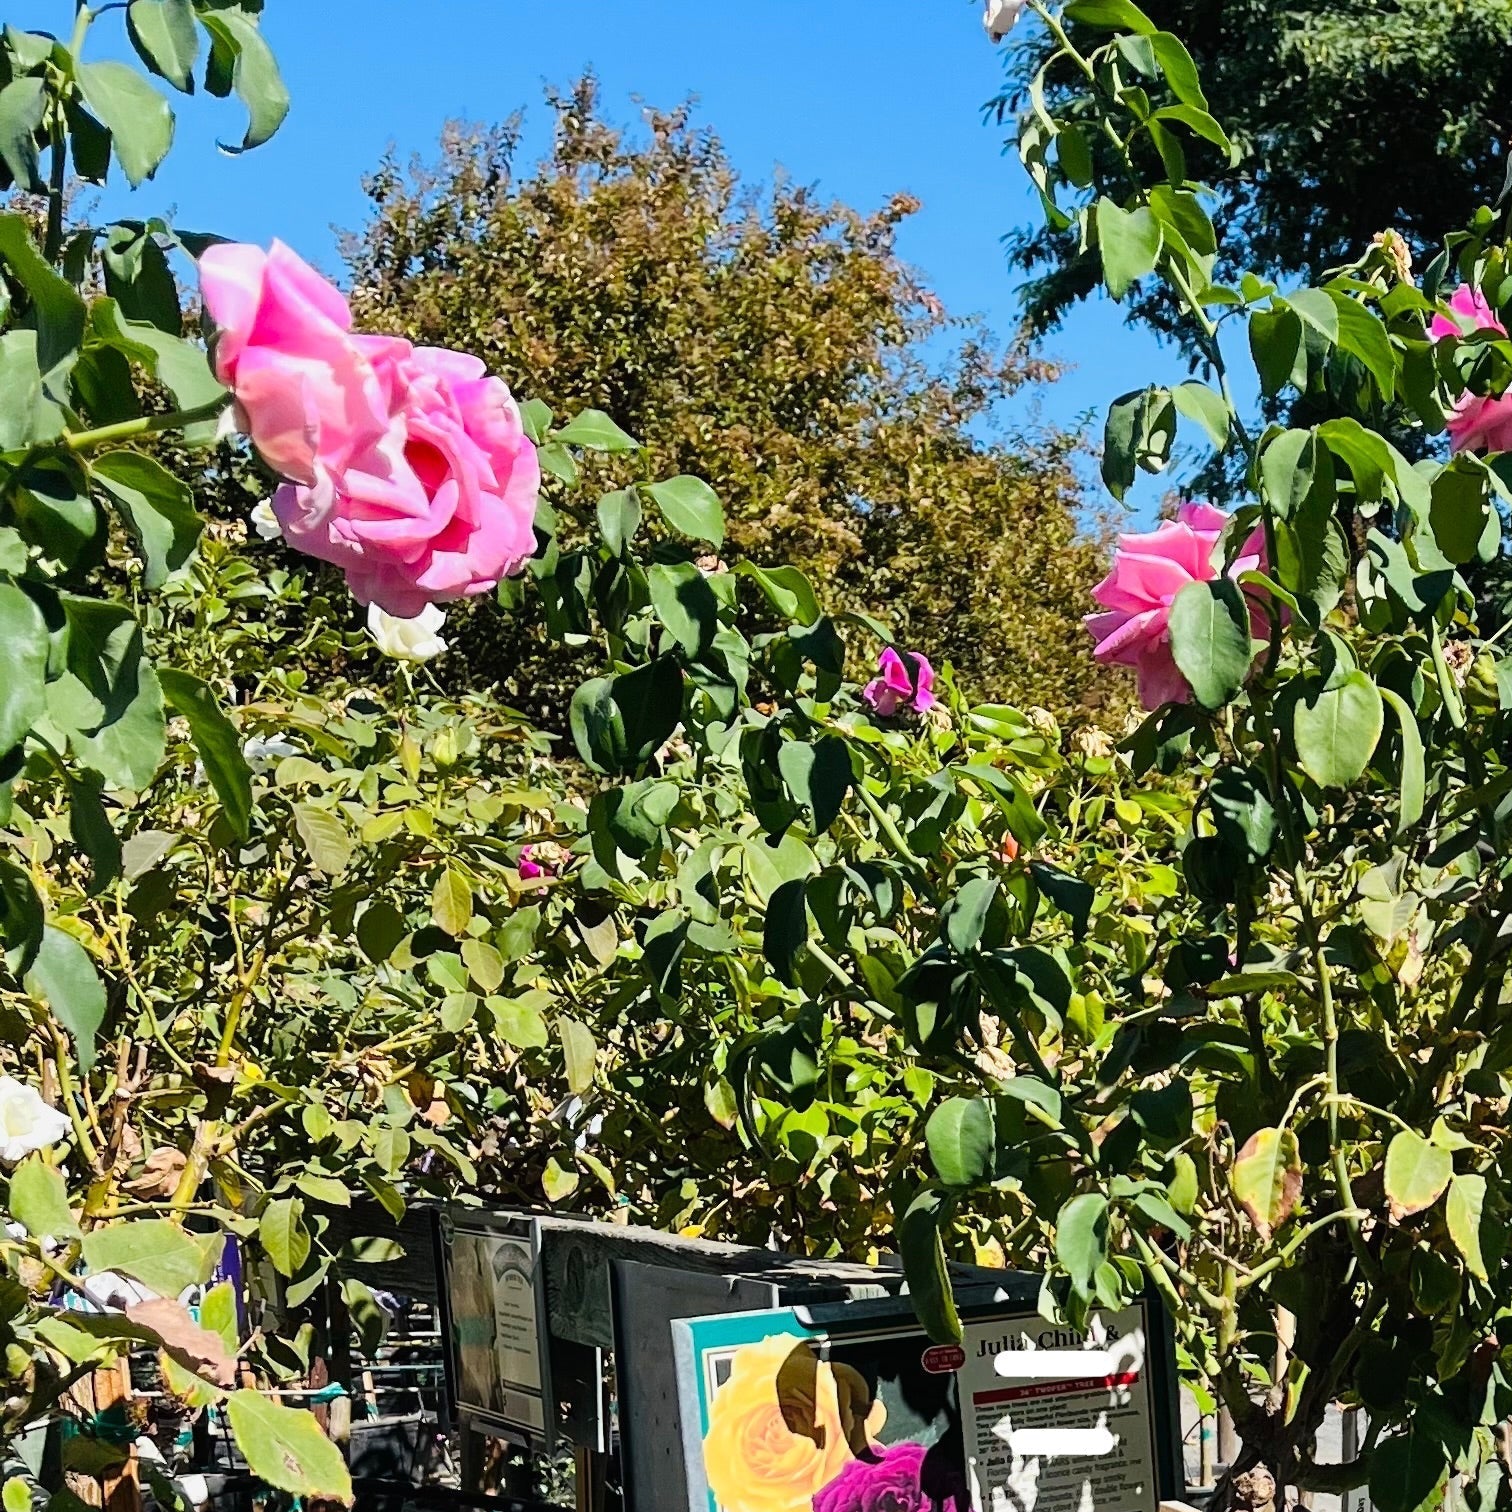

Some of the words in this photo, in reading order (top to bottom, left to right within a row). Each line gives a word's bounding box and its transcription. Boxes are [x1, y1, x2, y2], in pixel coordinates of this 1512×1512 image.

[977, 1334, 1028, 1358] Julia
[1037, 1325, 1097, 1350] Chil
[1106, 1325, 1120, 1341] &
